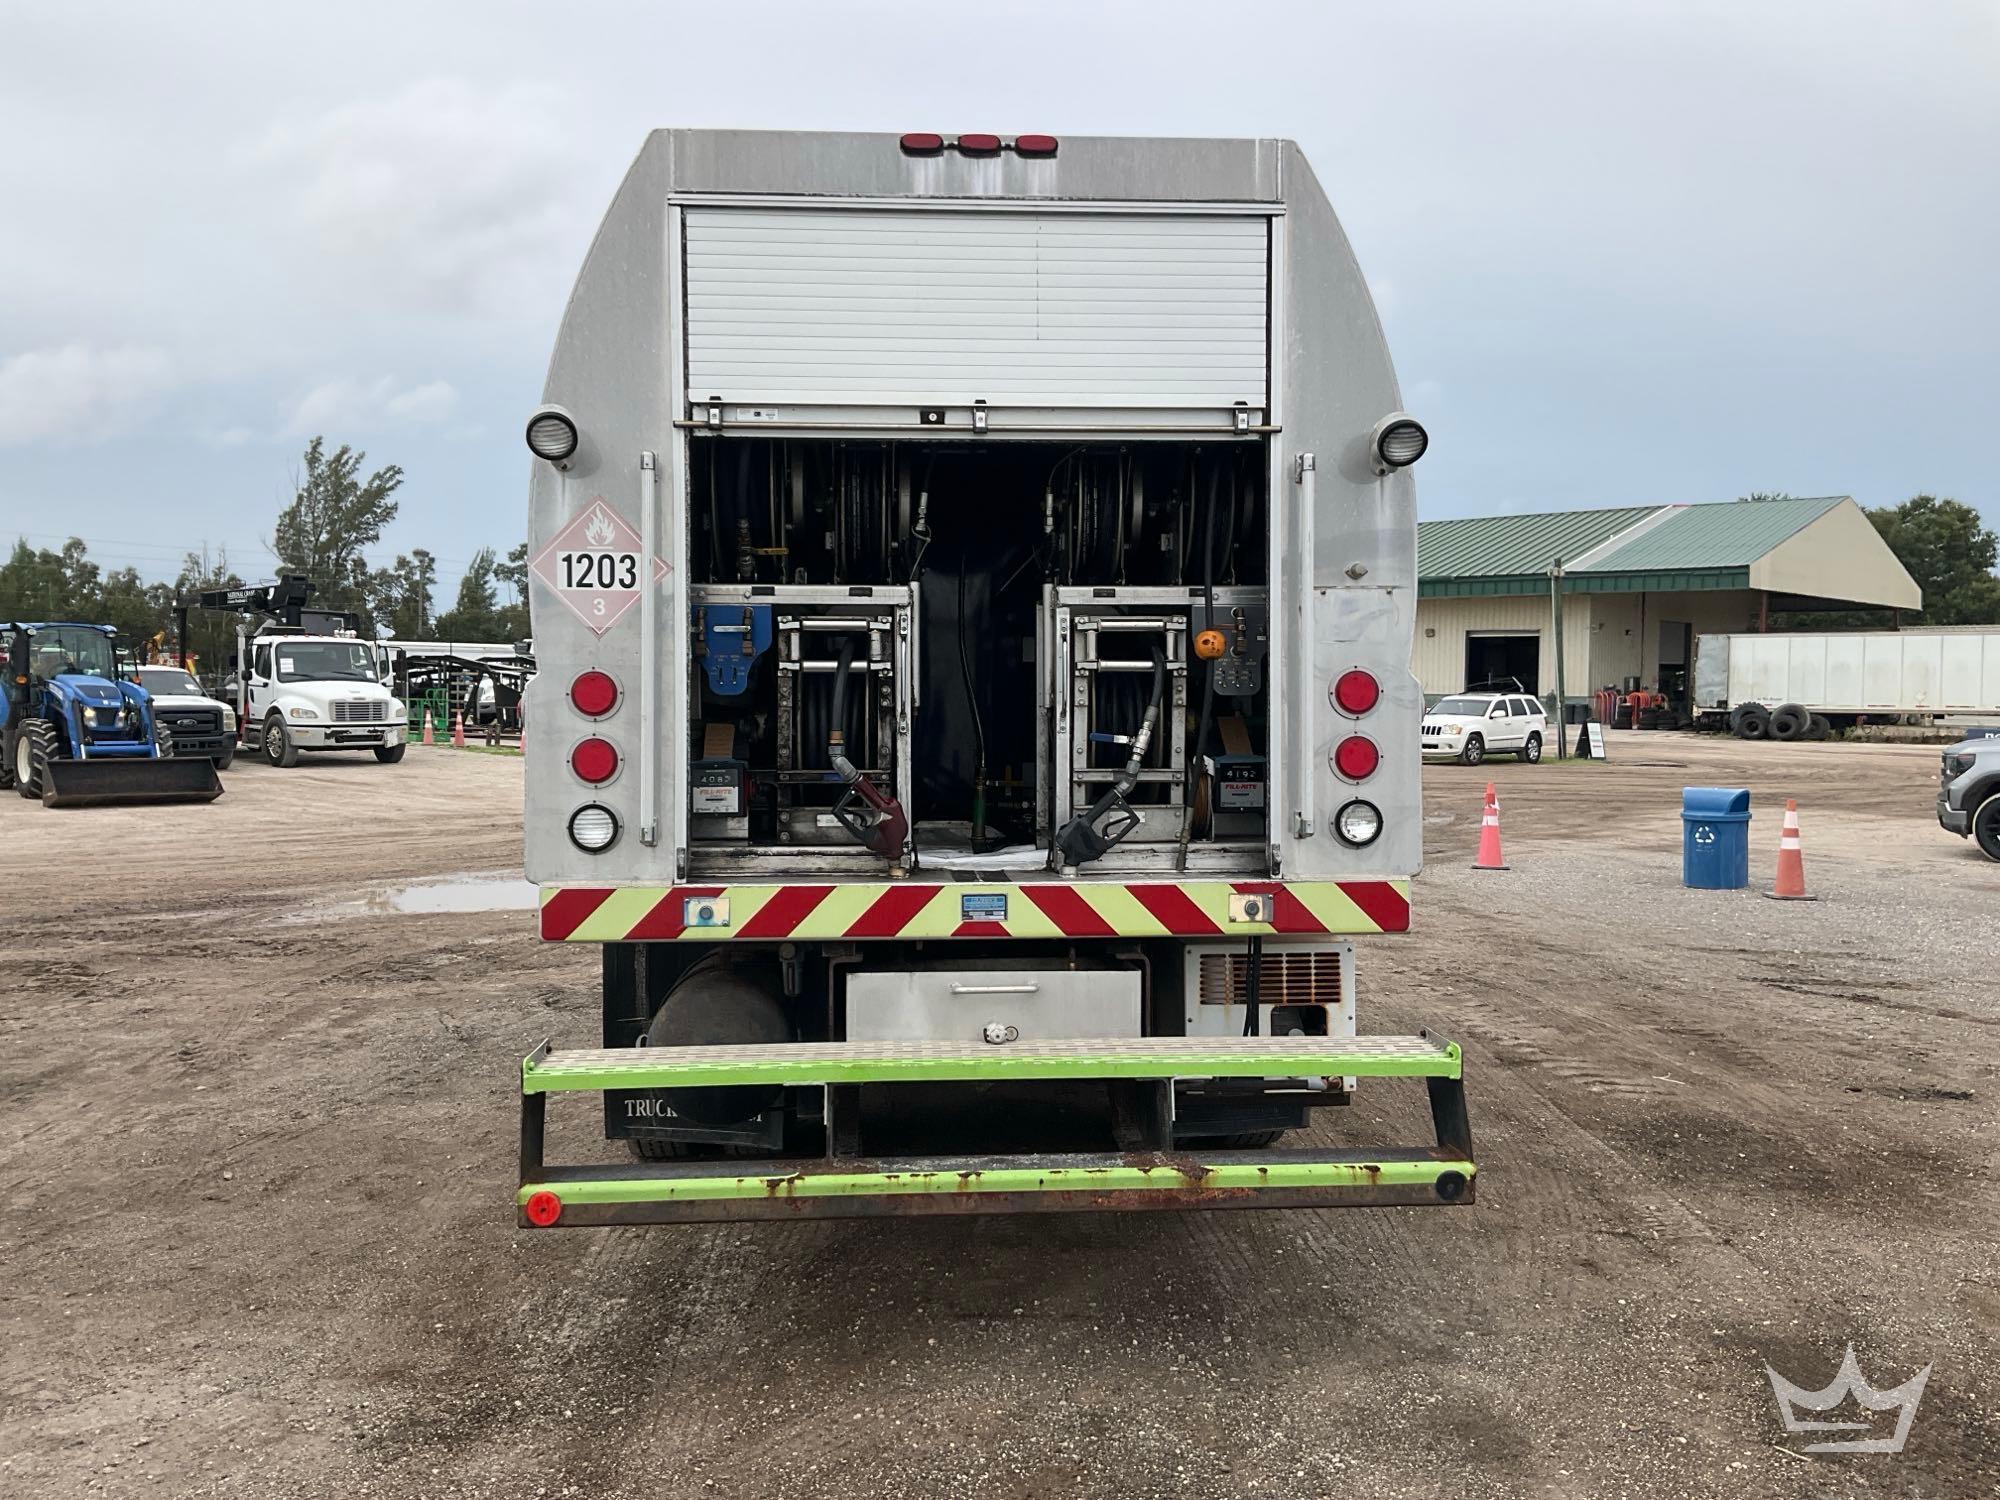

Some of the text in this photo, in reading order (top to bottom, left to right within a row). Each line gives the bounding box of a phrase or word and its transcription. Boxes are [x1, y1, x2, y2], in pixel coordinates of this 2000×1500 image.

[562, 553, 637, 589] 1203
[593, 598, 606, 616] 3
[624, 1099, 678, 1117] TRUCK
